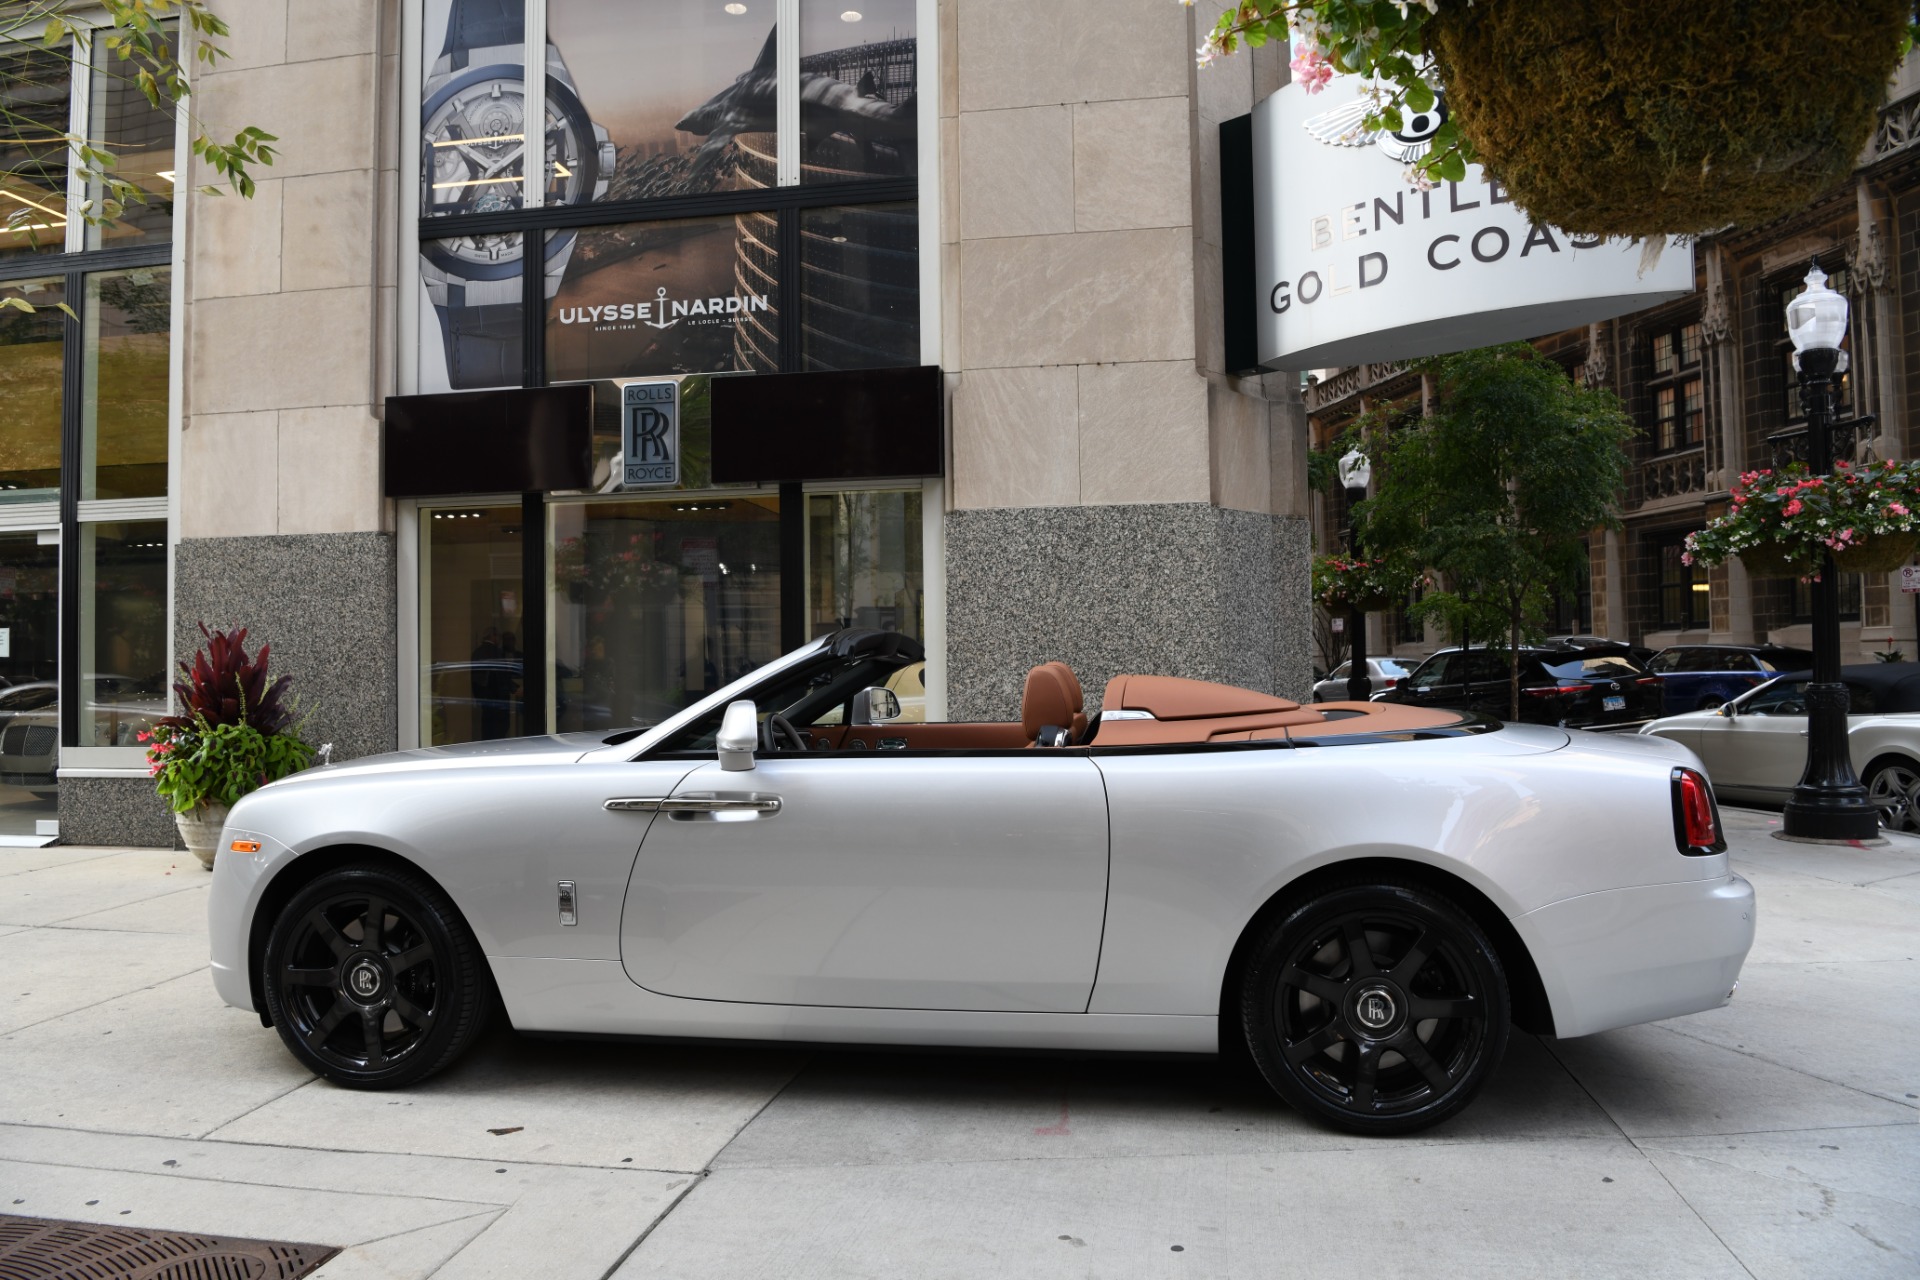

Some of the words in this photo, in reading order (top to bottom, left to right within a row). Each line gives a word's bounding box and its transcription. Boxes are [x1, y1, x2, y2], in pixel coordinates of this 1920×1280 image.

[1310, 180, 1509, 252] BENTLE
[1269, 251, 1388, 315] GOLD
[1427, 225, 1600, 271] COA
[559, 302, 652, 325] ULYSSE
[671, 294, 768, 317] NARDIN
[627, 388, 672, 401] ROLLS
[631, 407, 670, 462] RR
[627, 467, 672, 480] ROYCE
